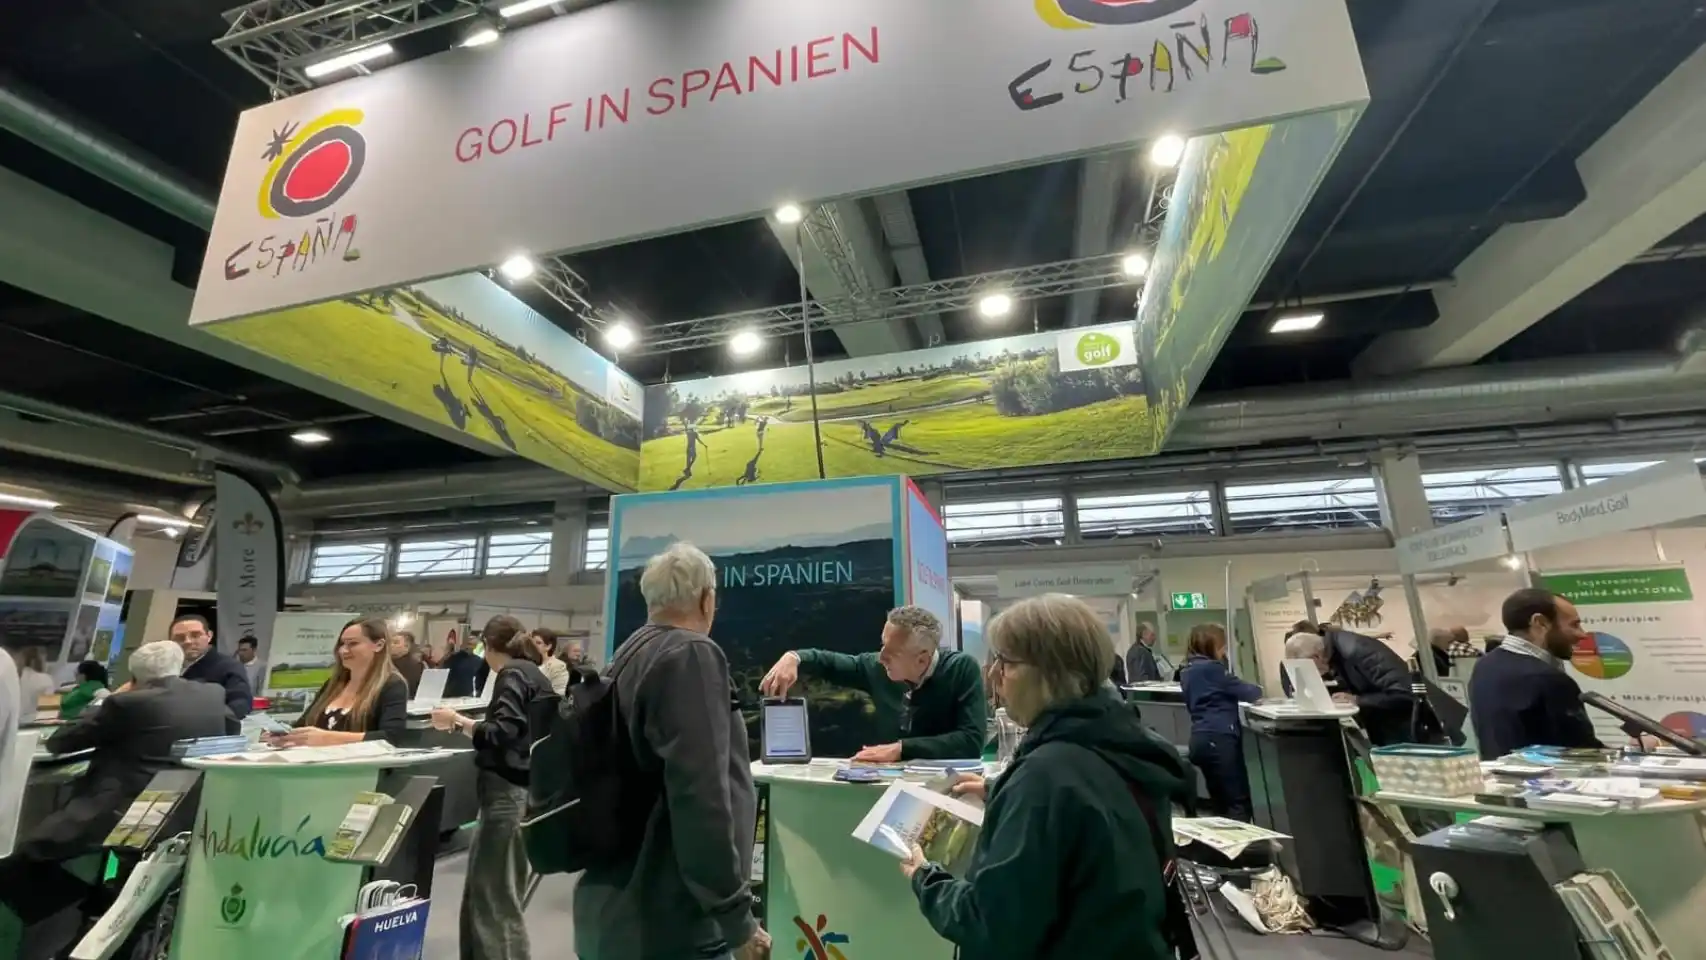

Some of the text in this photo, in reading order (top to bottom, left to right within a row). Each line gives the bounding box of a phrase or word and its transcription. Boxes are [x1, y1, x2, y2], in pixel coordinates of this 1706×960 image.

[1008, 12, 1287, 110] ESPAÑA
[454, 26, 880, 163] GOLF IN SPANIEN
[225, 212, 361, 281] ESPAÑA
[1083, 343, 1112, 362] golf
[238, 549, 256, 588] More
[724, 561, 853, 588] IN SPANIEN
[374, 910, 418, 933] HUELVA
